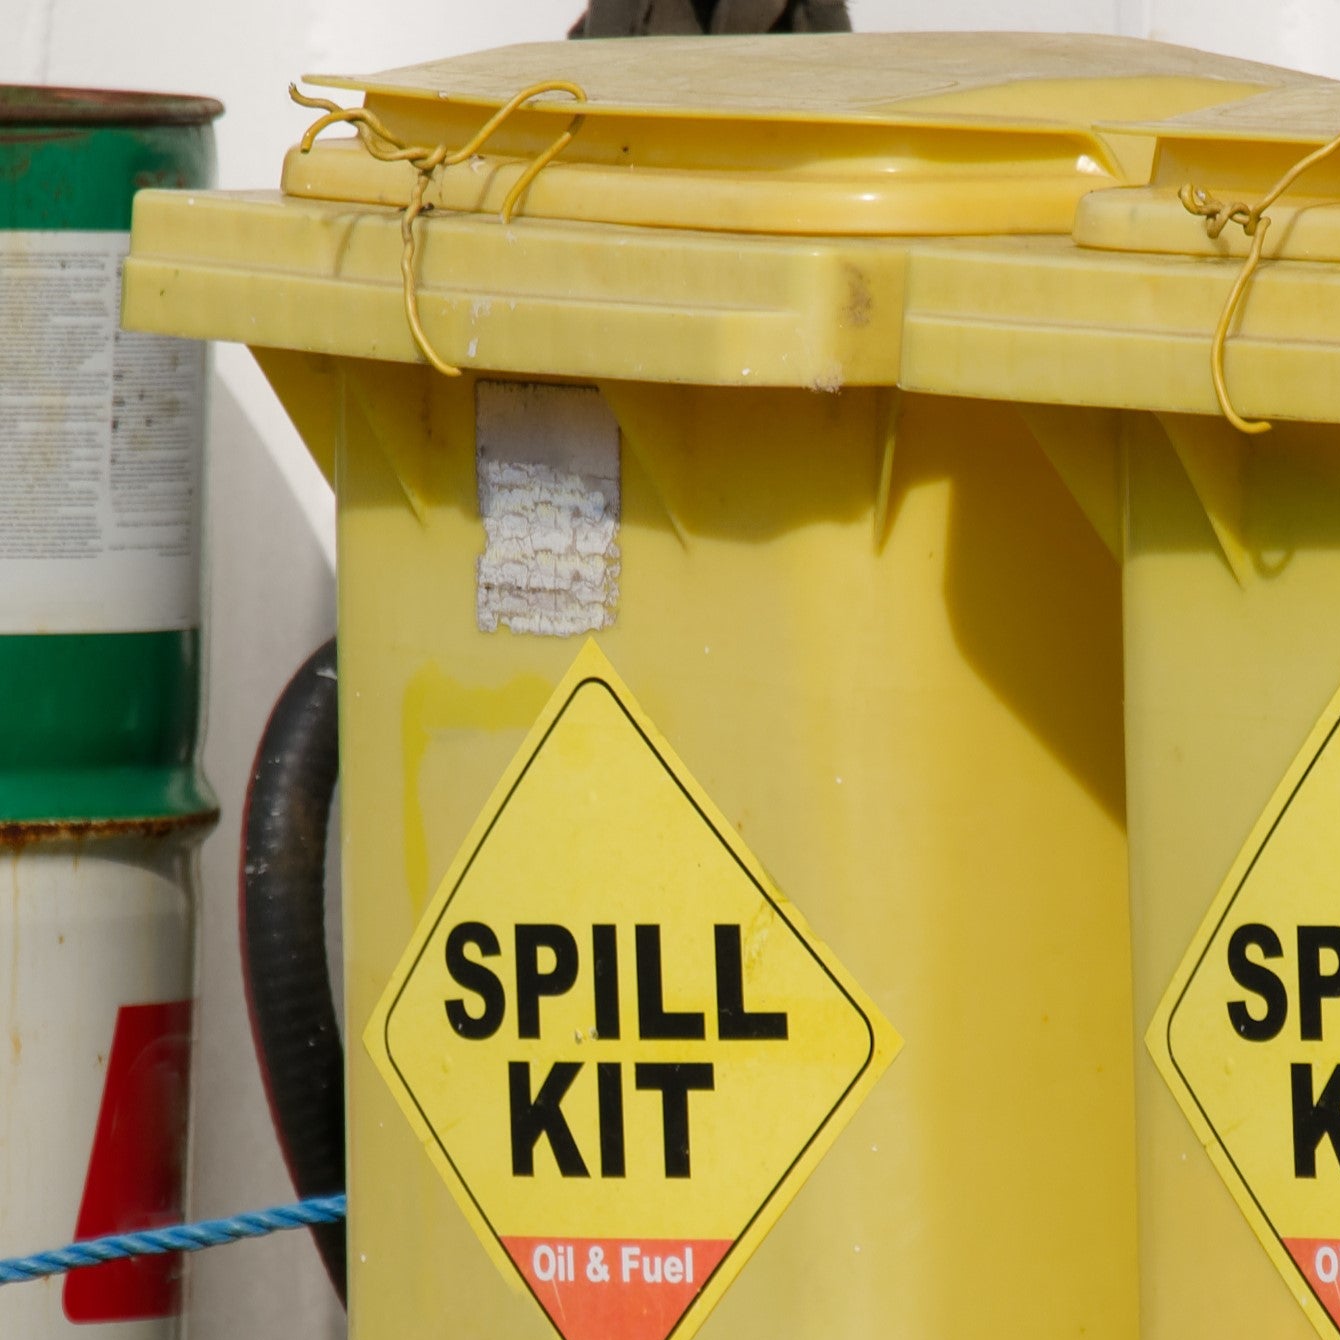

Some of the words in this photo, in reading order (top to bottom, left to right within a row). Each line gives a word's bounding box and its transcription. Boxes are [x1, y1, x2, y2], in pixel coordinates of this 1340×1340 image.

[445, 922, 787, 1040] SPILL
[509, 1062, 714, 1177] KIT
[532, 1244, 575, 1283] Oil
[586, 1245, 610, 1283] &
[621, 1246, 694, 1284] Fuel
